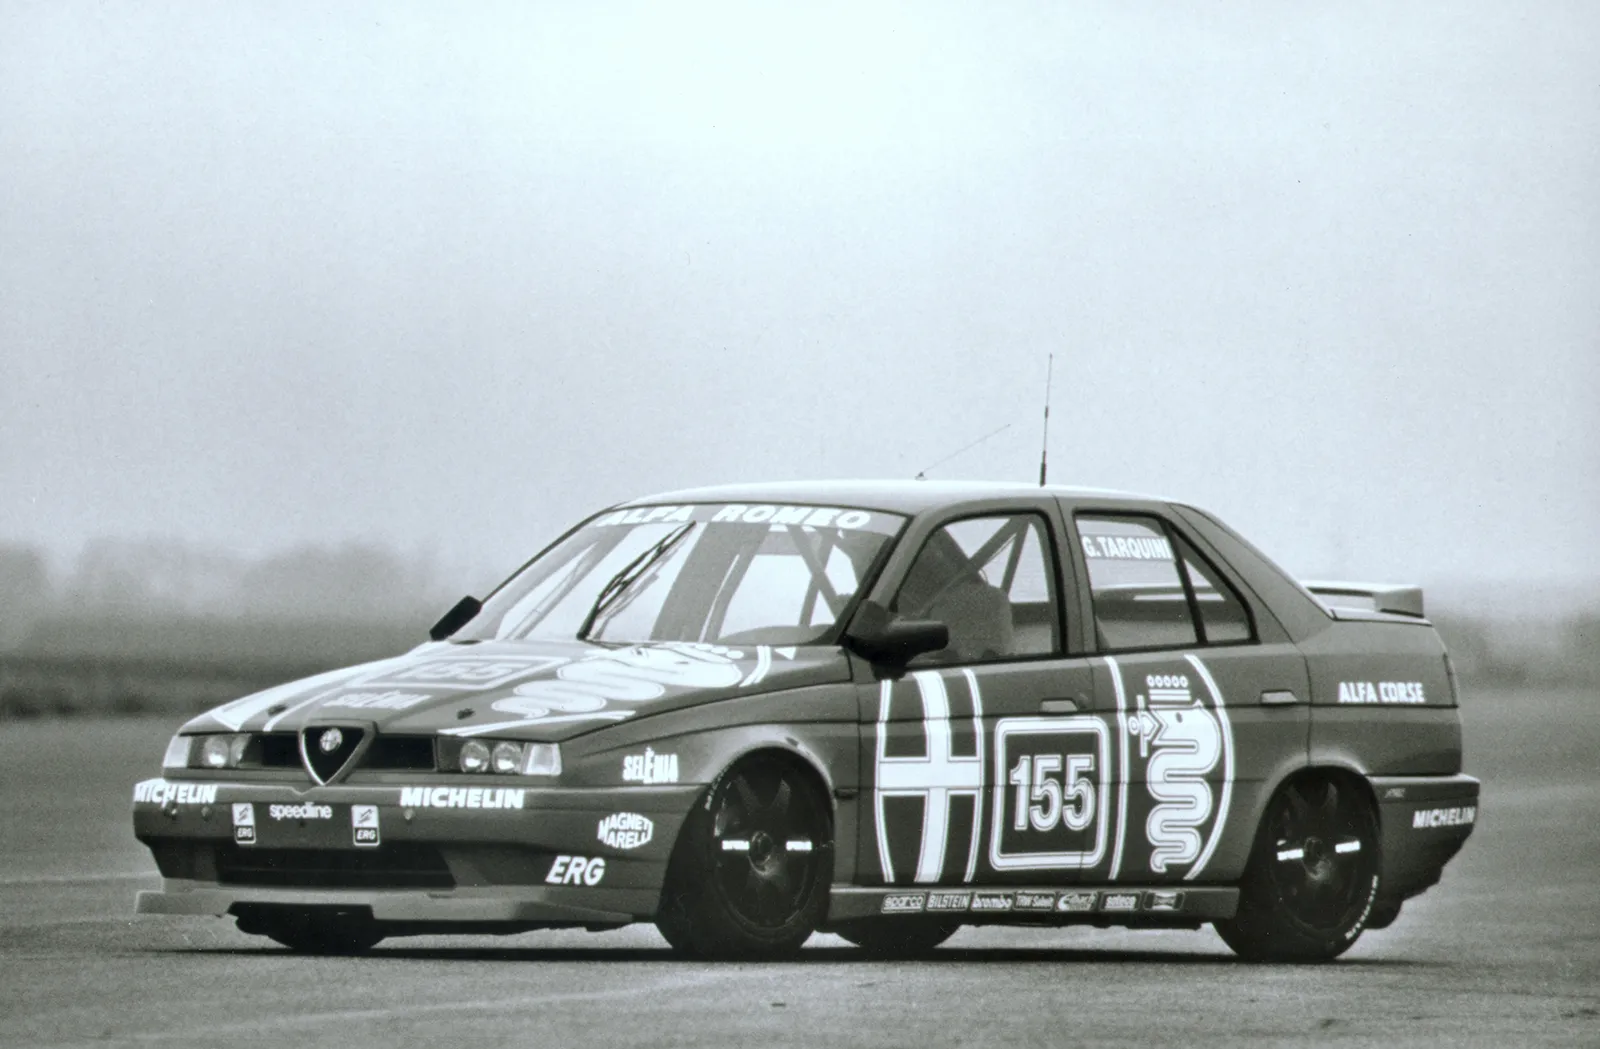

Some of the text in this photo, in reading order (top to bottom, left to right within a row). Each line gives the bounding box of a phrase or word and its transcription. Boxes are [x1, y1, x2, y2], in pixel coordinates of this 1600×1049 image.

[711, 504, 871, 529] ROMEO
[1338, 681, 1426, 704] ALFA CORSE
[133, 783, 218, 804] MICHELIN
[401, 786, 525, 809] MICHELIN
[1009, 754, 1097, 832] 155
[269, 801, 332, 821] speedline
[1412, 807, 1476, 829] MICHELIN
[356, 829, 376, 841] ERG
[546, 855, 606, 886] ERG
[928, 895, 970, 908] BILSTEIN
